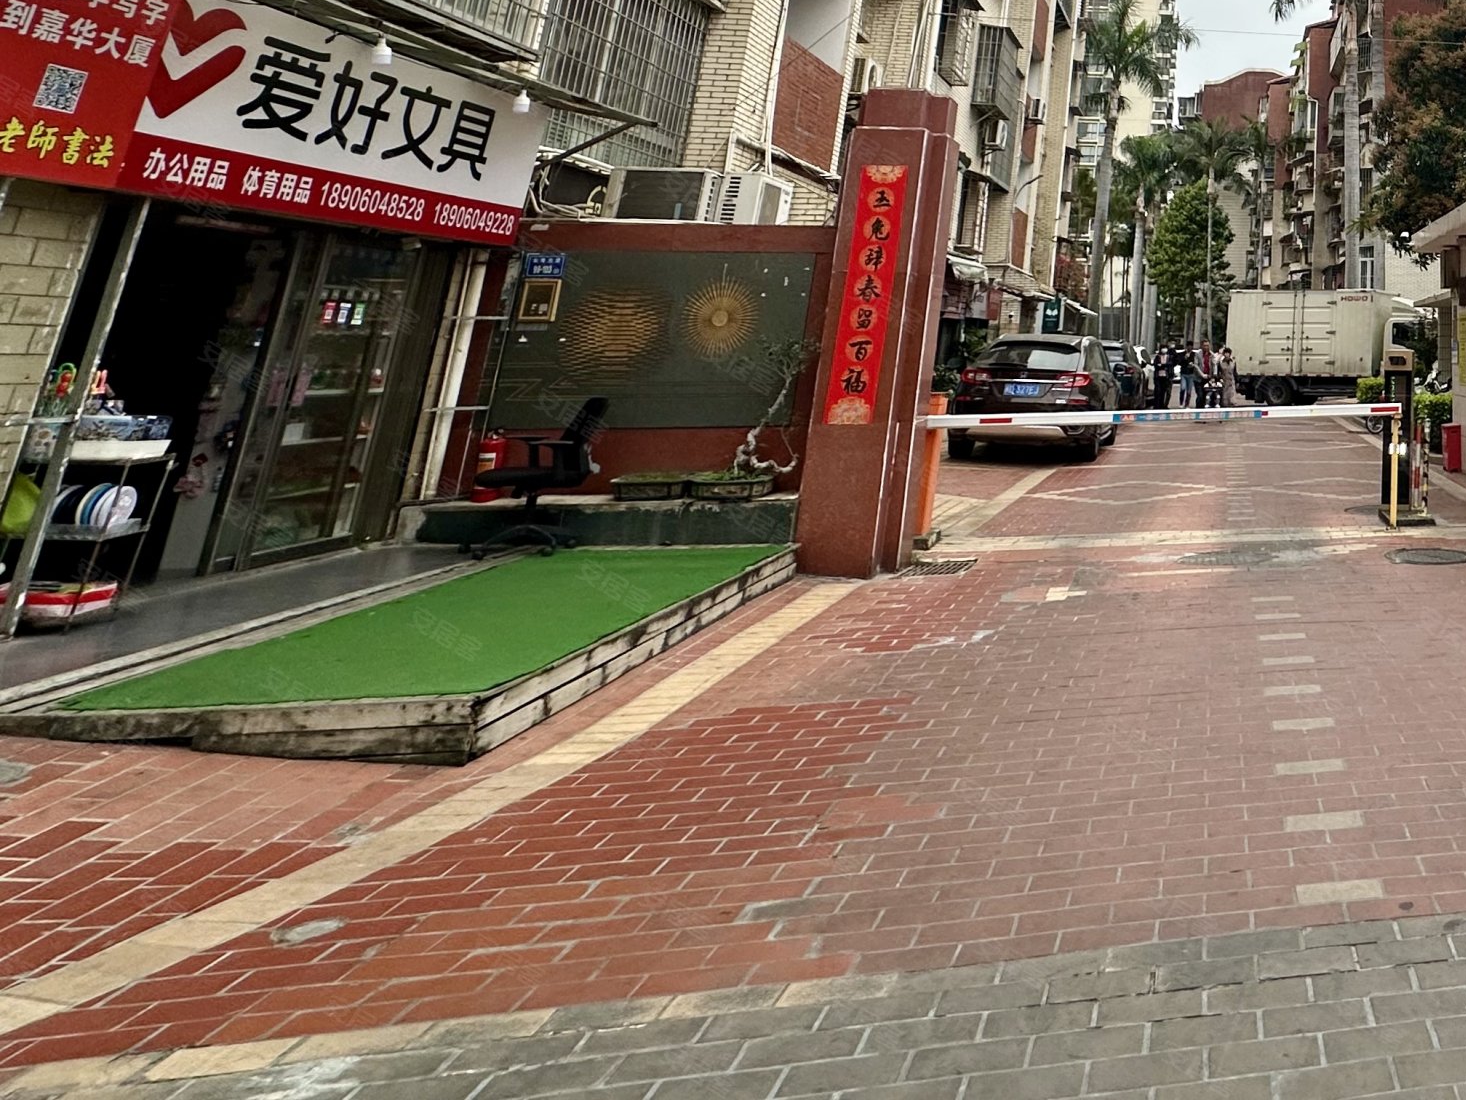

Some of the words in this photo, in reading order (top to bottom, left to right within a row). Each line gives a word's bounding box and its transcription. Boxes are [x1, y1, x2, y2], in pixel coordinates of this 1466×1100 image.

[236, 35, 497, 181] 爱好文具
[142, 147, 230, 191] 办公用品
[241, 165, 314, 205] 体育用品
[319, 180, 424, 222] 18906048528
[433, 201, 515, 236] 18906049228
